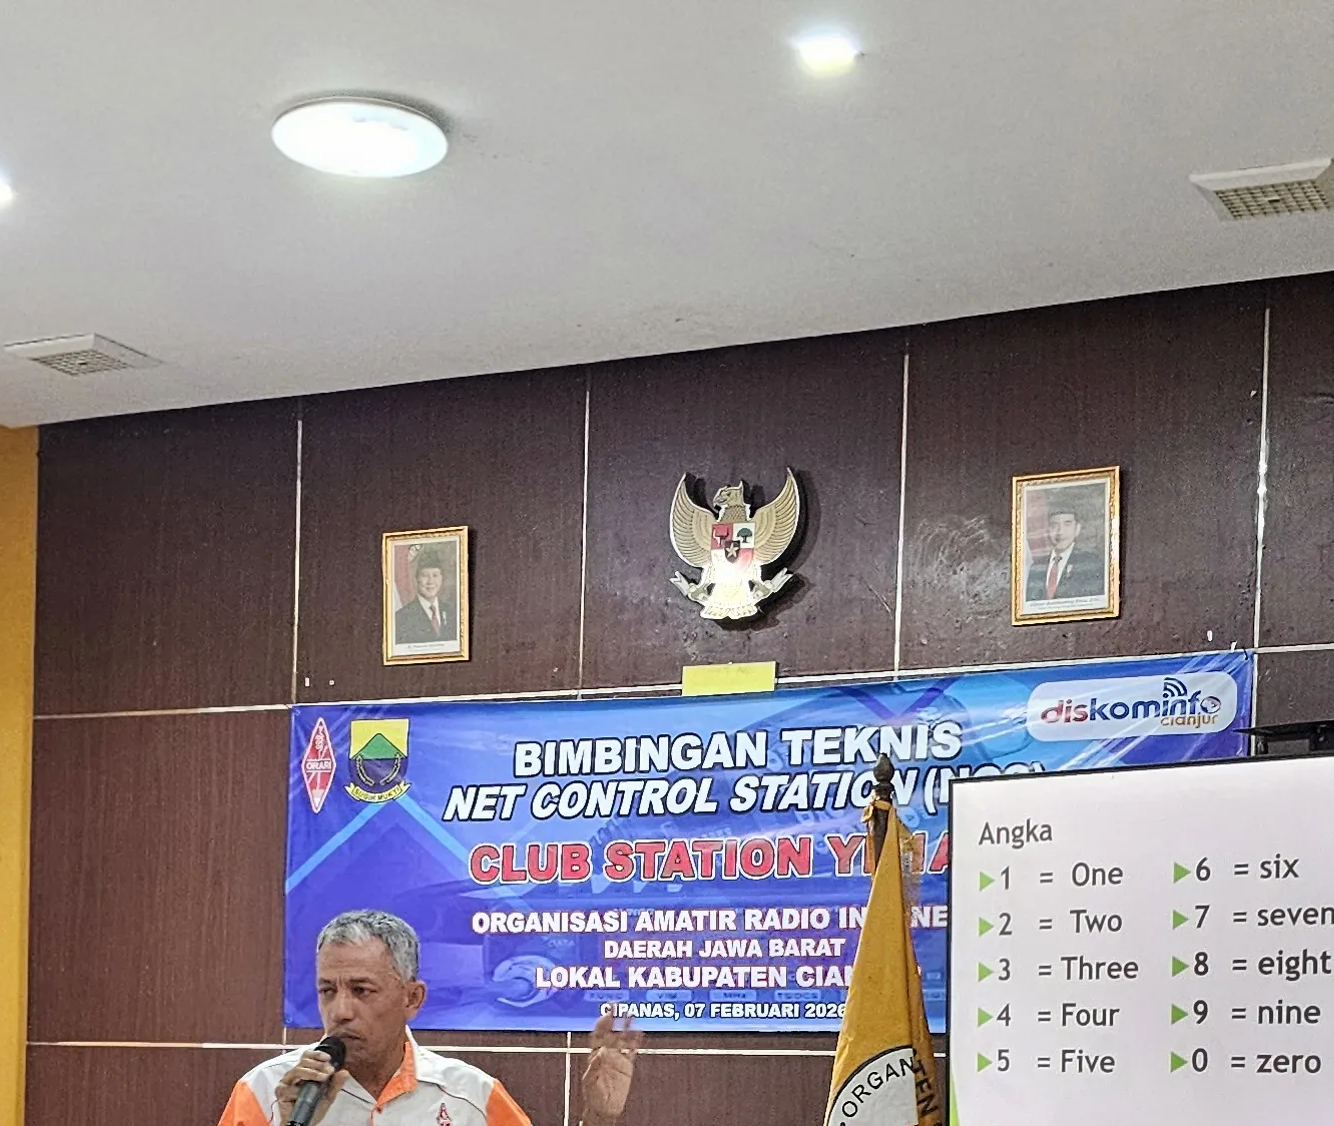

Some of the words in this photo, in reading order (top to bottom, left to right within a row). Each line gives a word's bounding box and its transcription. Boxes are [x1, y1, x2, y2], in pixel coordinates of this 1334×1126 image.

[1040, 690, 1222, 723] diskominfo
[1160, 713, 1219, 729] cianjur
[514, 730, 768, 778] BIMBINGAN
[781, 720, 963, 766] TEKNIS
[442, 783, 527, 821] NET
[531, 777, 718, 820] CONTROL
[978, 818, 1053, 850] Angka
[469, 840, 593, 886] CLUB
[603, 835, 813, 884] STATION
[1195, 857, 1211, 882] 6
[1259, 853, 1300, 879] six
[1000, 865, 1011, 890] 1
[1071, 862, 1124, 887] One
[471, 910, 628, 935] ORGANISASI
[635, 909, 737, 932] AMATIR
[744, 907, 831, 931] RADIO
[998, 912, 1013, 936] 2
[1069, 909, 1123, 934] Two
[1194, 904, 1210, 929] 7
[604, 940, 693, 960] DAERAH
[698, 938, 763, 959] JAWA
[768, 937, 847, 958] BARAT
[536, 966, 621, 990] LOKAL
[628, 965, 787, 989] KABUPATEN
[998, 958, 1011, 981] 3
[1060, 955, 1139, 981] Three
[1193, 951, 1209, 976] 8
[1257, 949, 1332, 982] eight
[599, 1002, 680, 1021] CIPANAS,
[684, 1003, 706, 1019] 07
[710, 1002, 800, 1019] FEBRUARI
[996, 1003, 1011, 1027] 4
[1061, 1003, 1120, 1027] Four
[1193, 1000, 1209, 1025] 9
[1257, 1000, 1321, 1025] nine
[997, 1049, 1010, 1072] 5
[1061, 1049, 1116, 1073] Five
[1191, 1048, 1208, 1073] 0
[1256, 1054, 1322, 1074] zero
[842, 1057, 915, 1118] ORGAN
